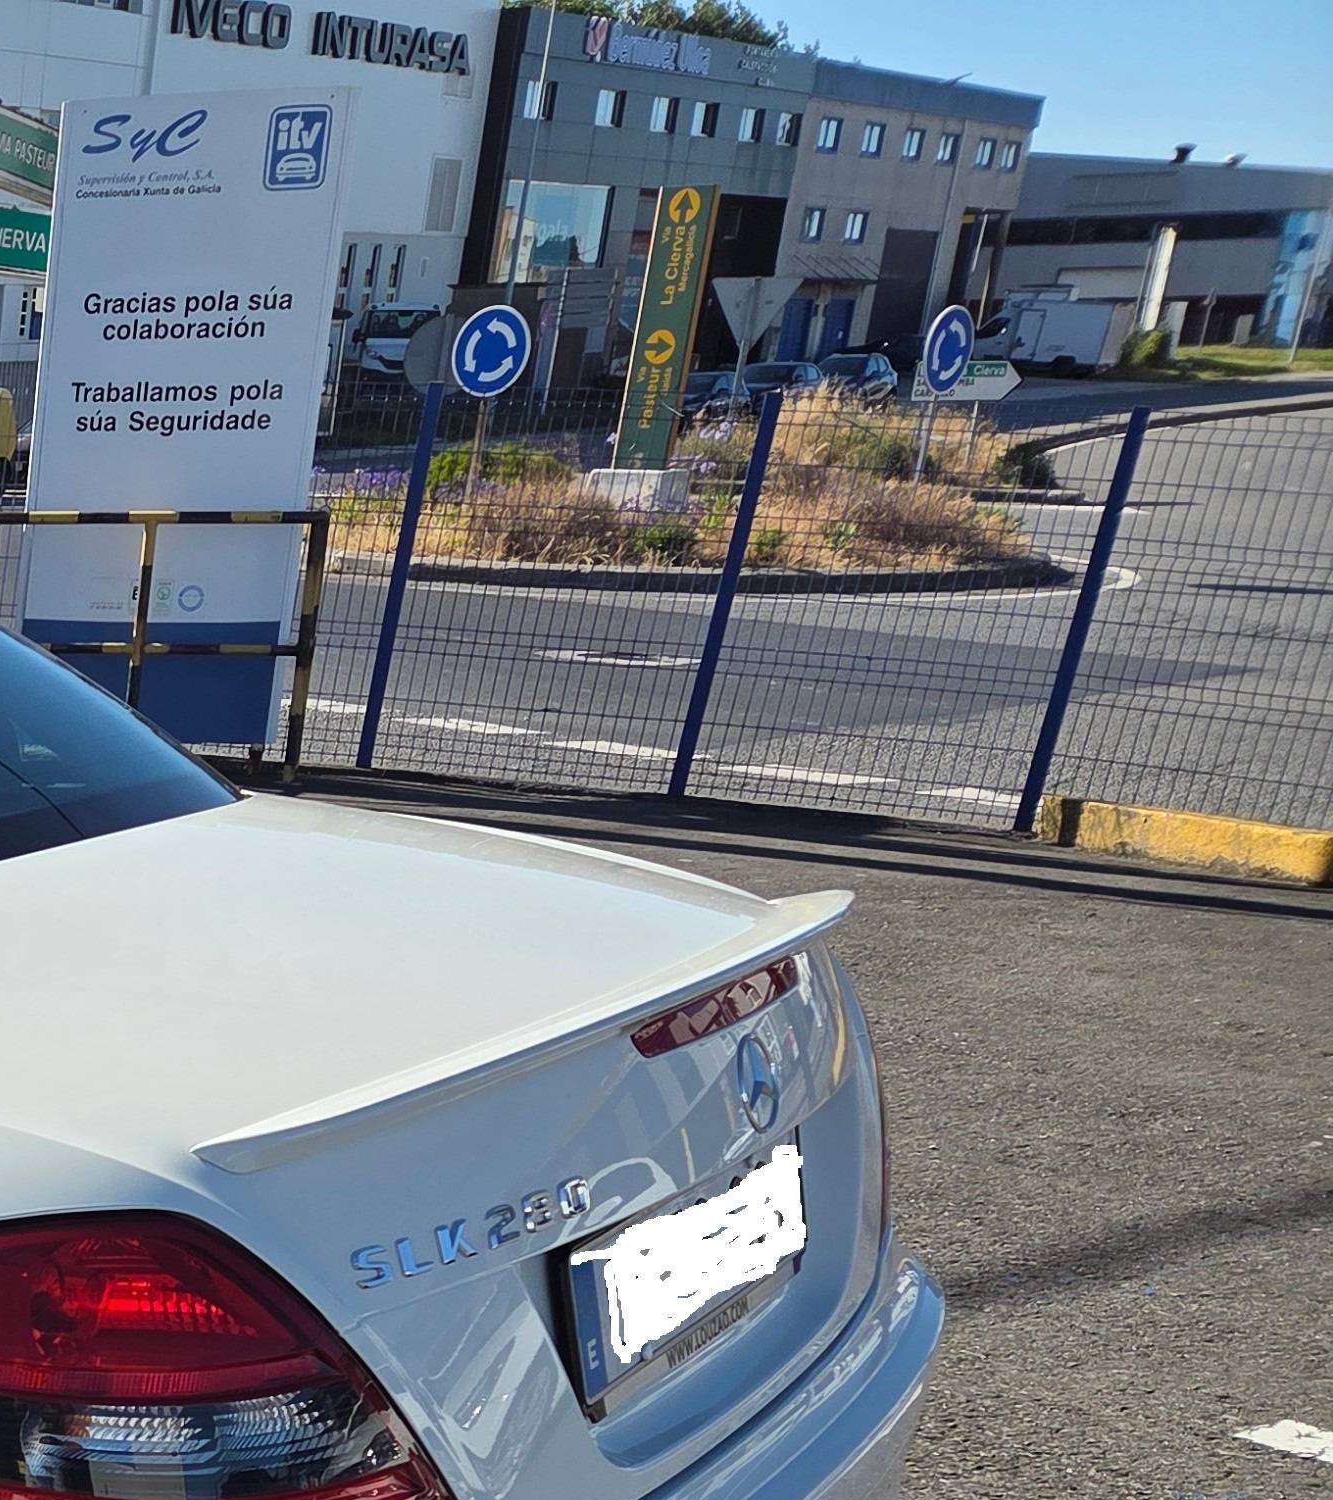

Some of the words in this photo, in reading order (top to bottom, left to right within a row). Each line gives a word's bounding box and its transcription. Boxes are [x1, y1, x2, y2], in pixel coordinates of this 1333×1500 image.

[169, 0, 293, 50] IVECO
[309, 10, 471, 76] INTURASA
[81, 108, 209, 164] SyC
[276, 111, 324, 151] itv
[13, 137, 56, 173] PASTEUR
[75, 187, 141, 199] Concesionaria
[143, 186, 170, 197] Xunta
[172, 185, 185, 195] de
[187, 183, 222, 195] Galicia
[77, 170, 137, 188] Supervisión
[136, 174, 146, 186] y
[192, 169, 215, 181] S.A.
[664, 225, 687, 282] Cierva
[83, 292, 177, 315] Gracias
[183, 289, 240, 318] pola
[247, 285, 293, 311] súa
[660, 284, 674, 306] La
[102, 315, 266, 342] colaboración
[972, 364, 1006, 376] Cierva
[70, 380, 218, 403] Traballamos
[229, 378, 284, 407] pola
[75, 409, 117, 432] súa
[128, 408, 272, 437] Seguridade
[349, 1217, 479, 1290] SLK
[484, 1173, 592, 1251] 280
[587, 1337, 599, 1371] E
